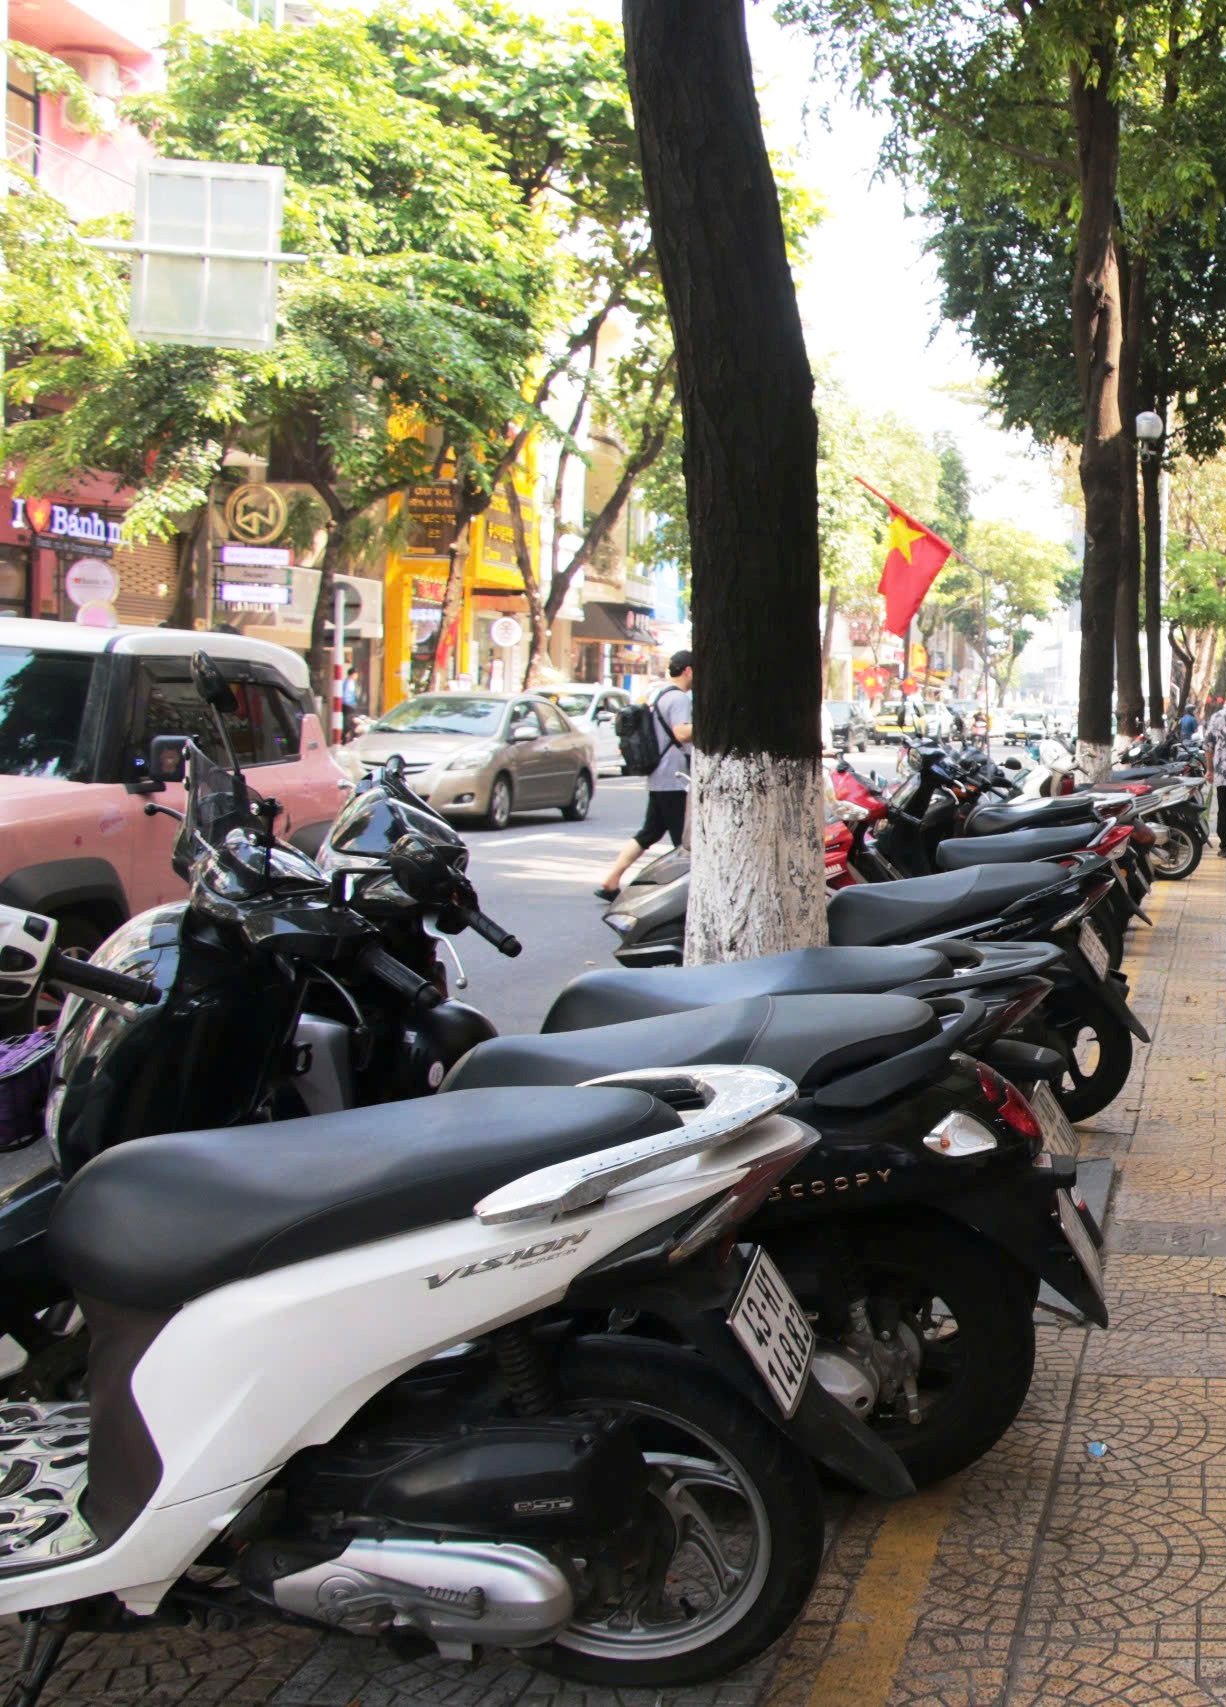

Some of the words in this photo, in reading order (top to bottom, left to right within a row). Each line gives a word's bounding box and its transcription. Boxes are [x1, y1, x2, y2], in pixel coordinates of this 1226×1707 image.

[50, 504, 107, 542] Bánh
[768, 1168, 891, 1201] SCOOPY
[423, 1227, 592, 1290] VISION
[741, 1264, 784, 1347] 43-H1
[767, 1302, 811, 1401] 148.83
